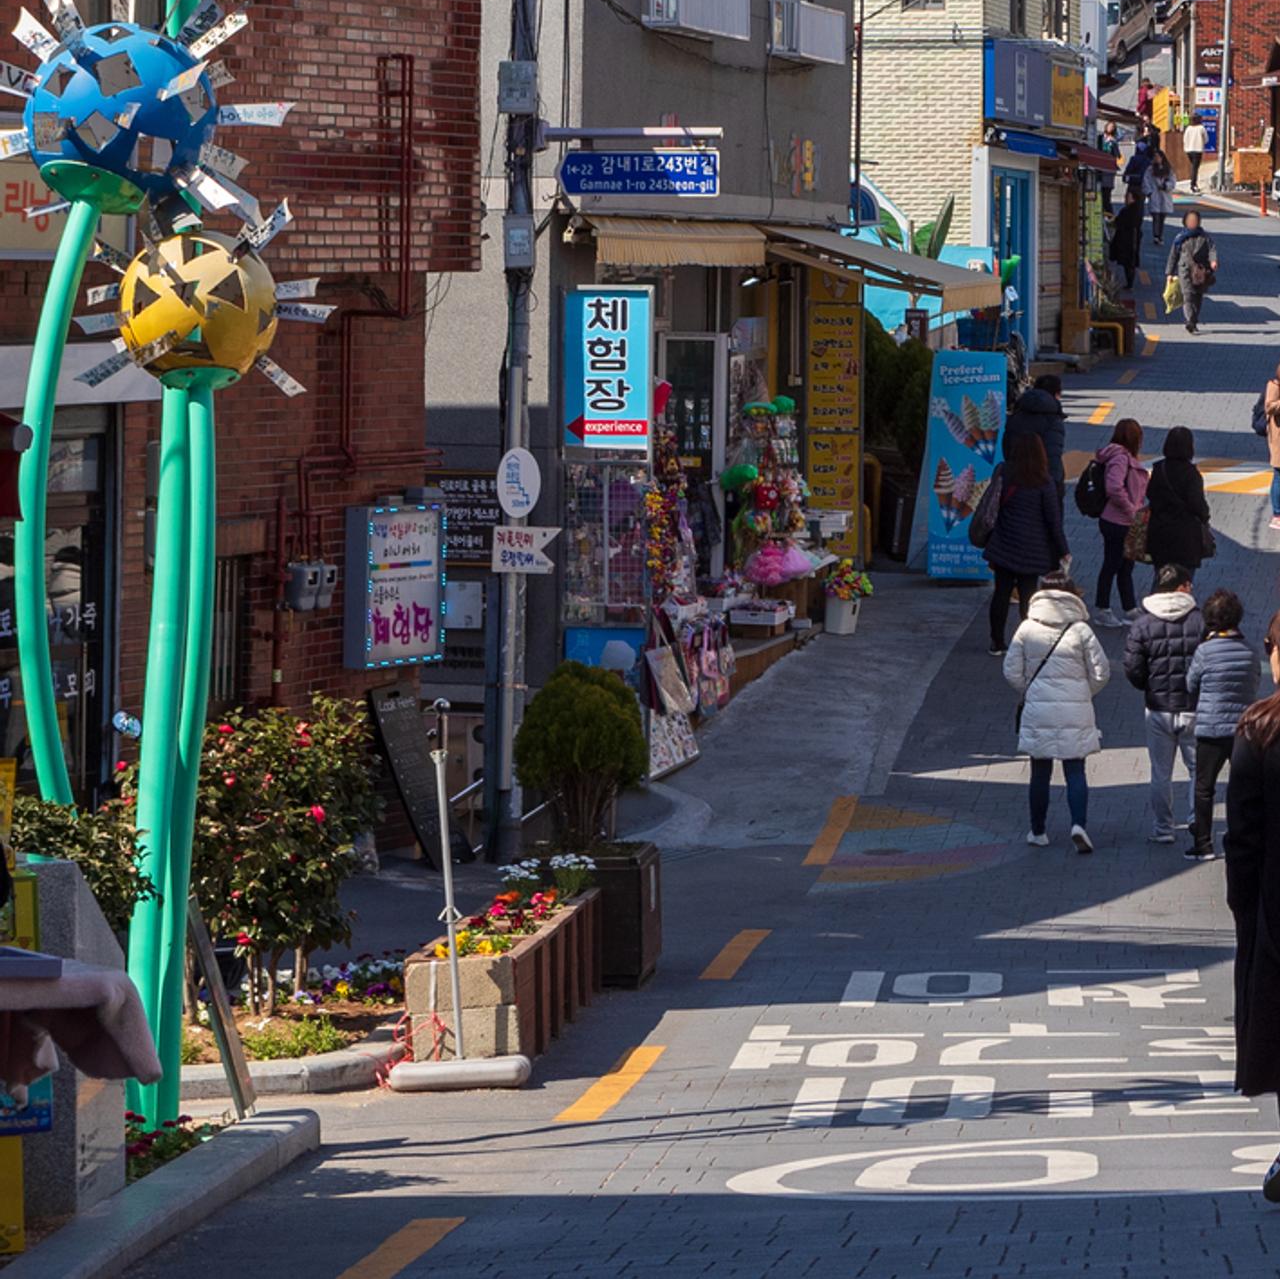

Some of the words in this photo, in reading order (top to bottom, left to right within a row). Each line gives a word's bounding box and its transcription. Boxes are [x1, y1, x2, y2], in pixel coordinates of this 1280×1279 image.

[601, 156, 715, 176] 감내1로243번길
[580, 178, 622, 191] Gamnae
[626, 178, 647, 191] 1-ro
[649, 179, 714, 193] 243beon-gil
[586, 298, 633, 412] 체험장
[943, 373, 1001, 385] ice-cream
[585, 420, 643, 434] experience
